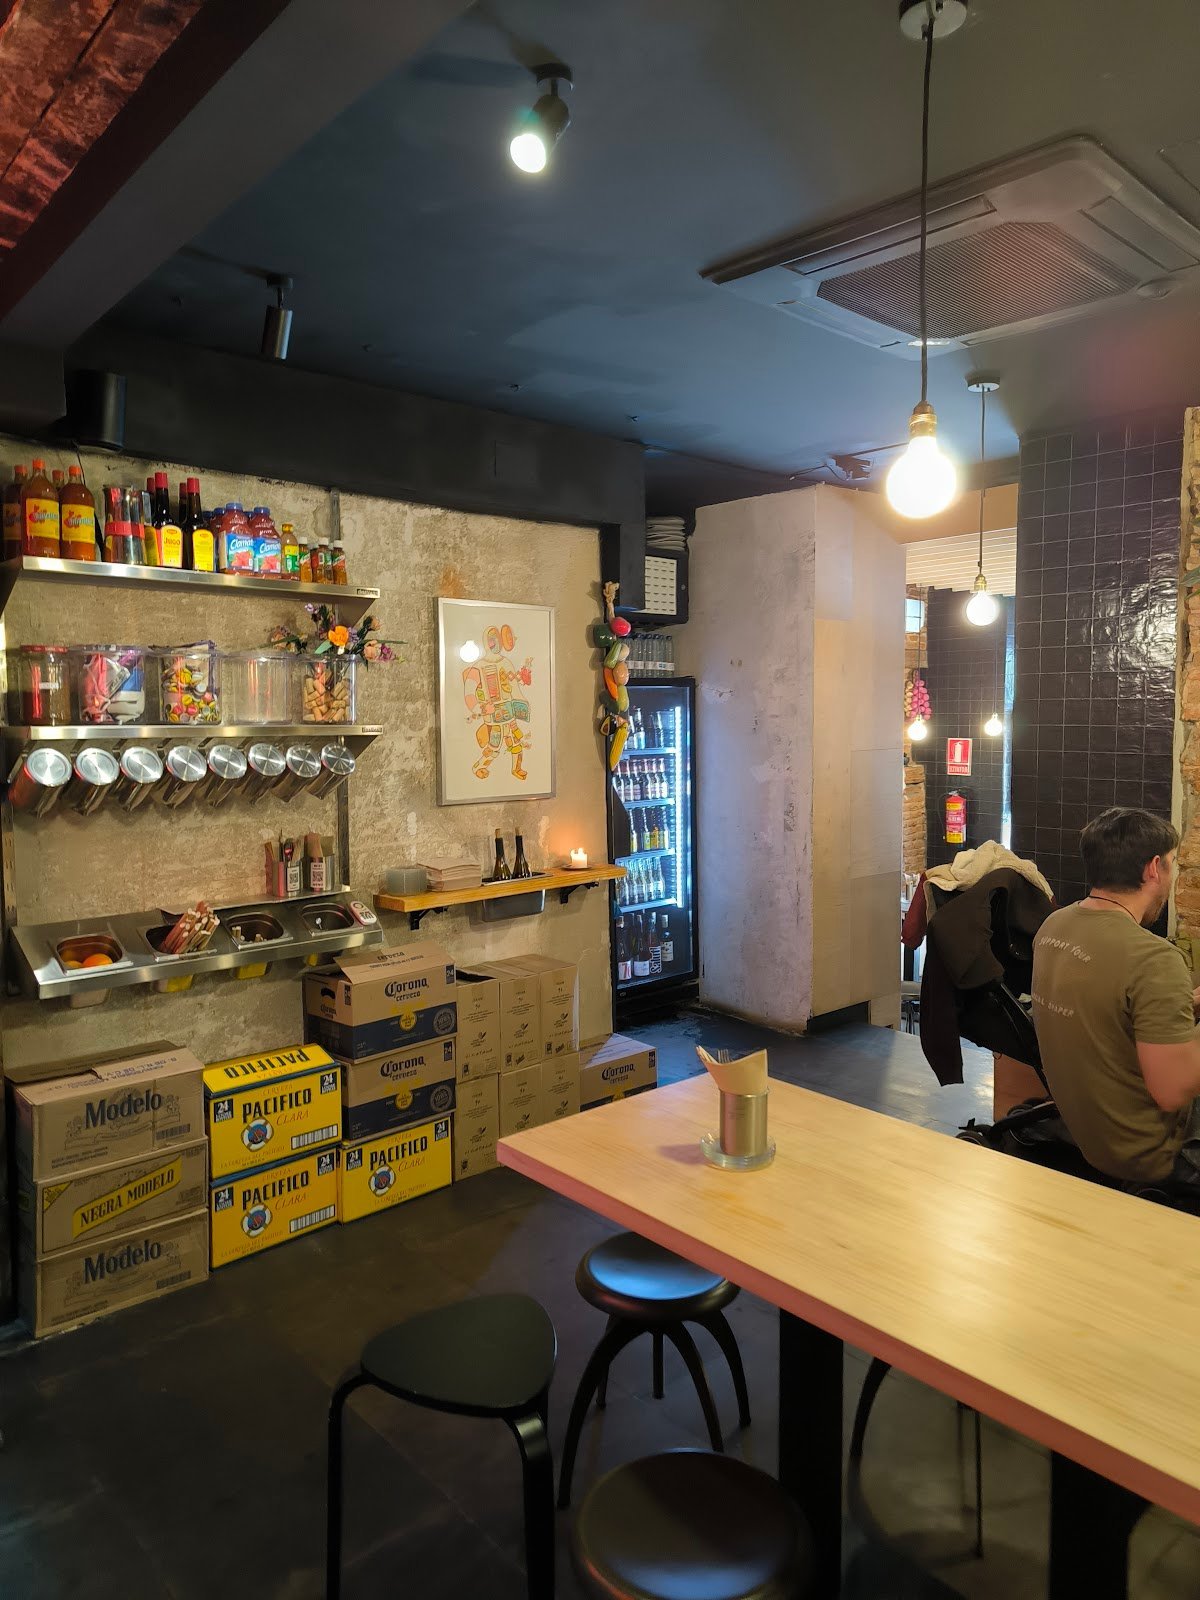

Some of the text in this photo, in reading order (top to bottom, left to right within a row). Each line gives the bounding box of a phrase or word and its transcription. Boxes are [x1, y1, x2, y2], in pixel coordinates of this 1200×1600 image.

[1039, 936, 1091, 963] SUPPORT YOUR
[385, 978, 429, 998] Corona
[395, 990, 421, 1002] cerveza
[223, 1049, 311, 1079] PACIFICO
[380, 1056, 425, 1078] Corona
[602, 1063, 634, 1081] Corona
[324, 1073, 333, 1086] 24
[392, 1069, 417, 1081] cerveza
[262, 1083, 293, 1097] CERVEZA
[85, 1090, 163, 1129] Modelo
[217, 1101, 229, 1114] 24
[242, 1088, 311, 1124] PACIFICO
[275, 1110, 309, 1127] CLARA
[437, 1122, 446, 1133] 24
[321, 1155, 330, 1167] 24
[349, 1151, 359, 1163] 24
[369, 1136, 428, 1170] PACIFICO
[398, 1157, 425, 1172] CLARA
[80, 1194, 122, 1228] NEGRA
[127, 1168, 174, 1201] MODELO
[218, 1188, 229, 1202] 24
[243, 1170, 309, 1210] PACIFICO
[275, 1194, 307, 1211] CLARA
[83, 1239, 161, 1284] Modelo
